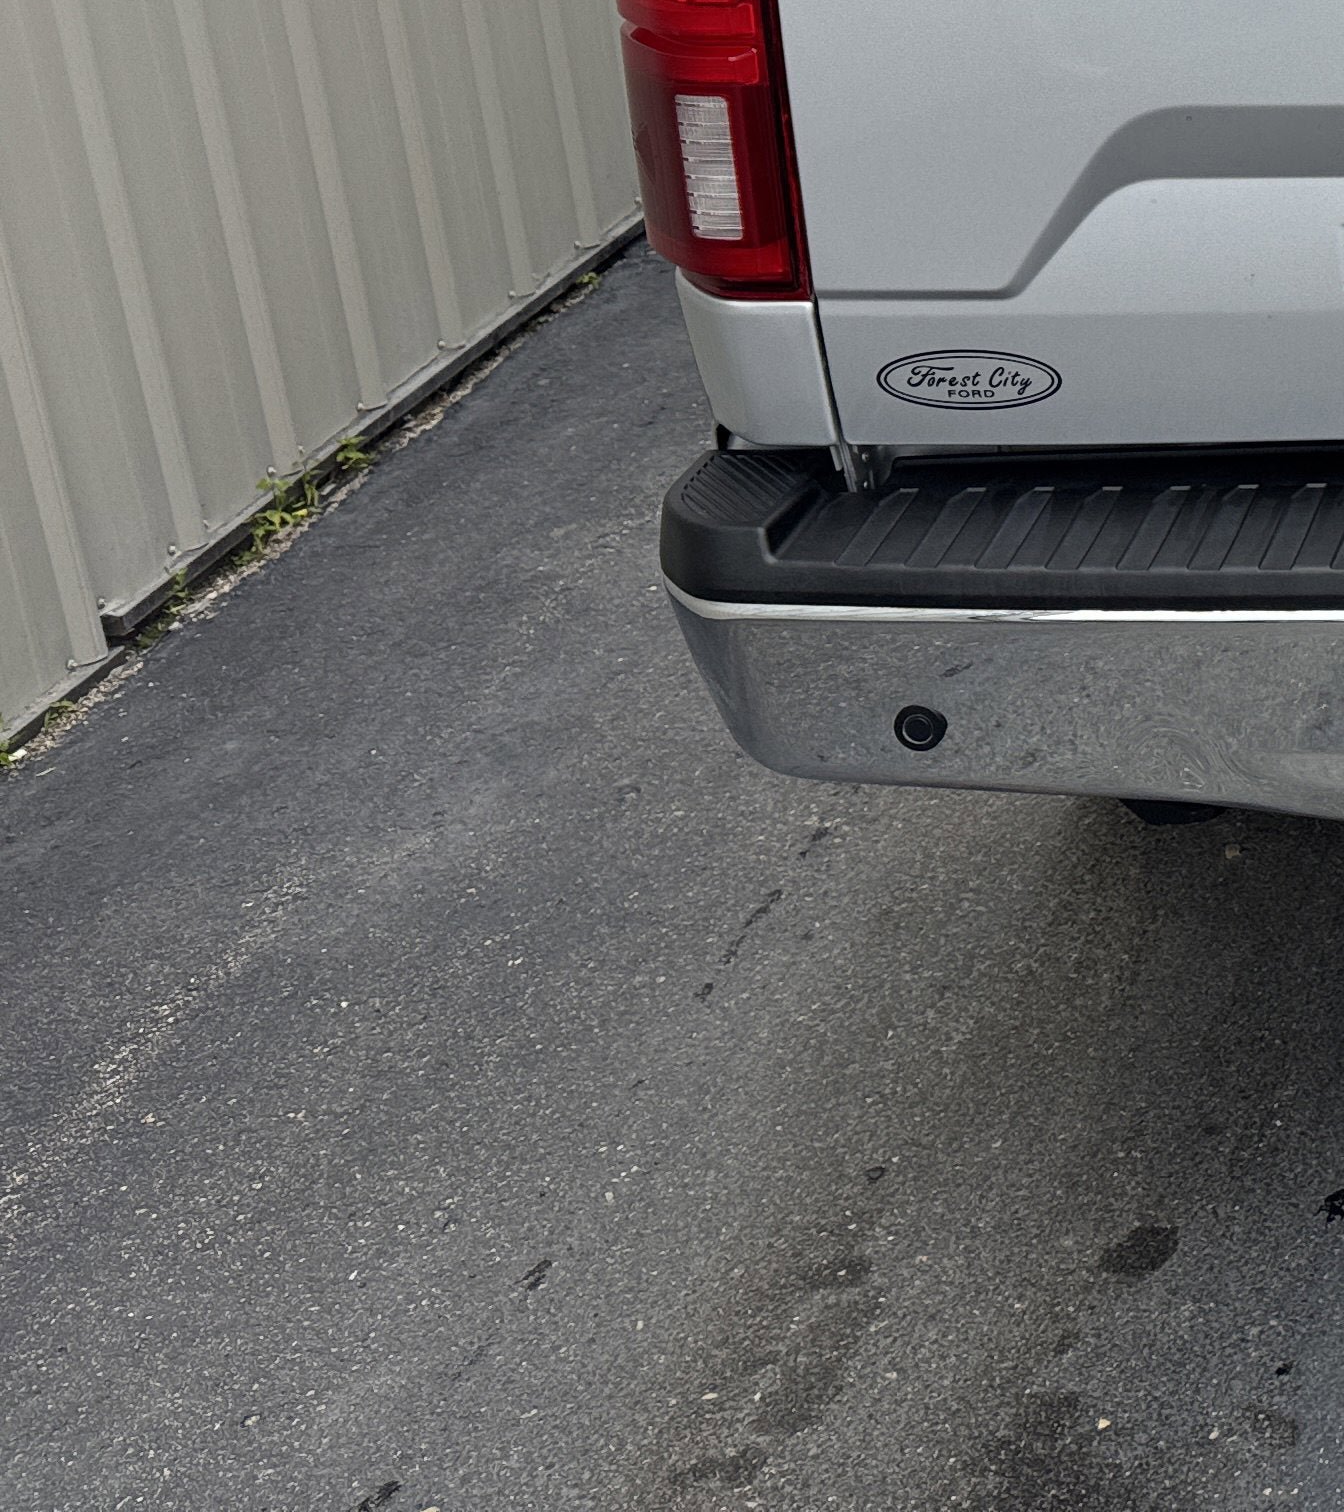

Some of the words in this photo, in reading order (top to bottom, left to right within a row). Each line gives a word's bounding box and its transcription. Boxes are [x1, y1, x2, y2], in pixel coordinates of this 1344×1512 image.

[906, 365, 983, 388] Forest
[988, 366, 1033, 396] City
[947, 389, 995, 399] FORD
